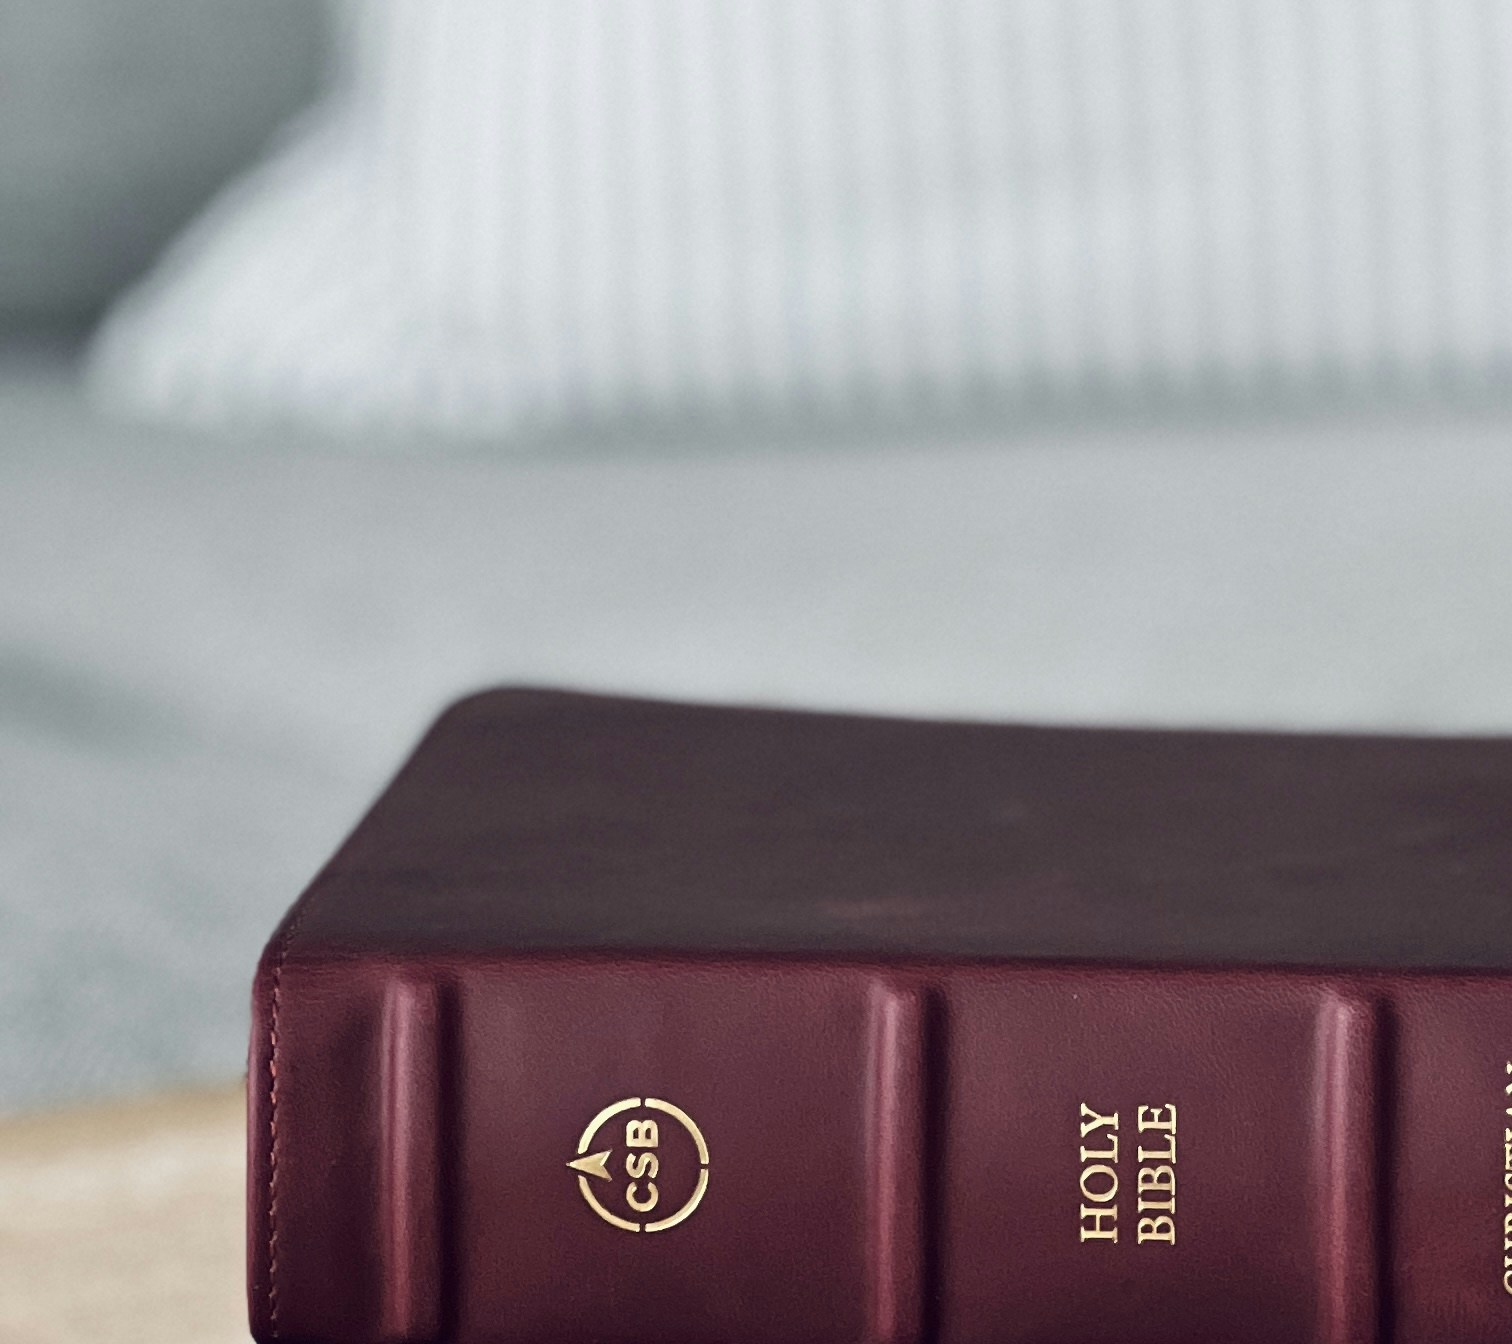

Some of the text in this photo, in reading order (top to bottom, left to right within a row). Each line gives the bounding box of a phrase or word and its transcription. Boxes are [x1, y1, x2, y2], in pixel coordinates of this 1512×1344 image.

[626, 1120, 658, 1212] CSB
[1080, 1103, 1119, 1243] HOLY
[1138, 1104, 1176, 1245] BIBLE
